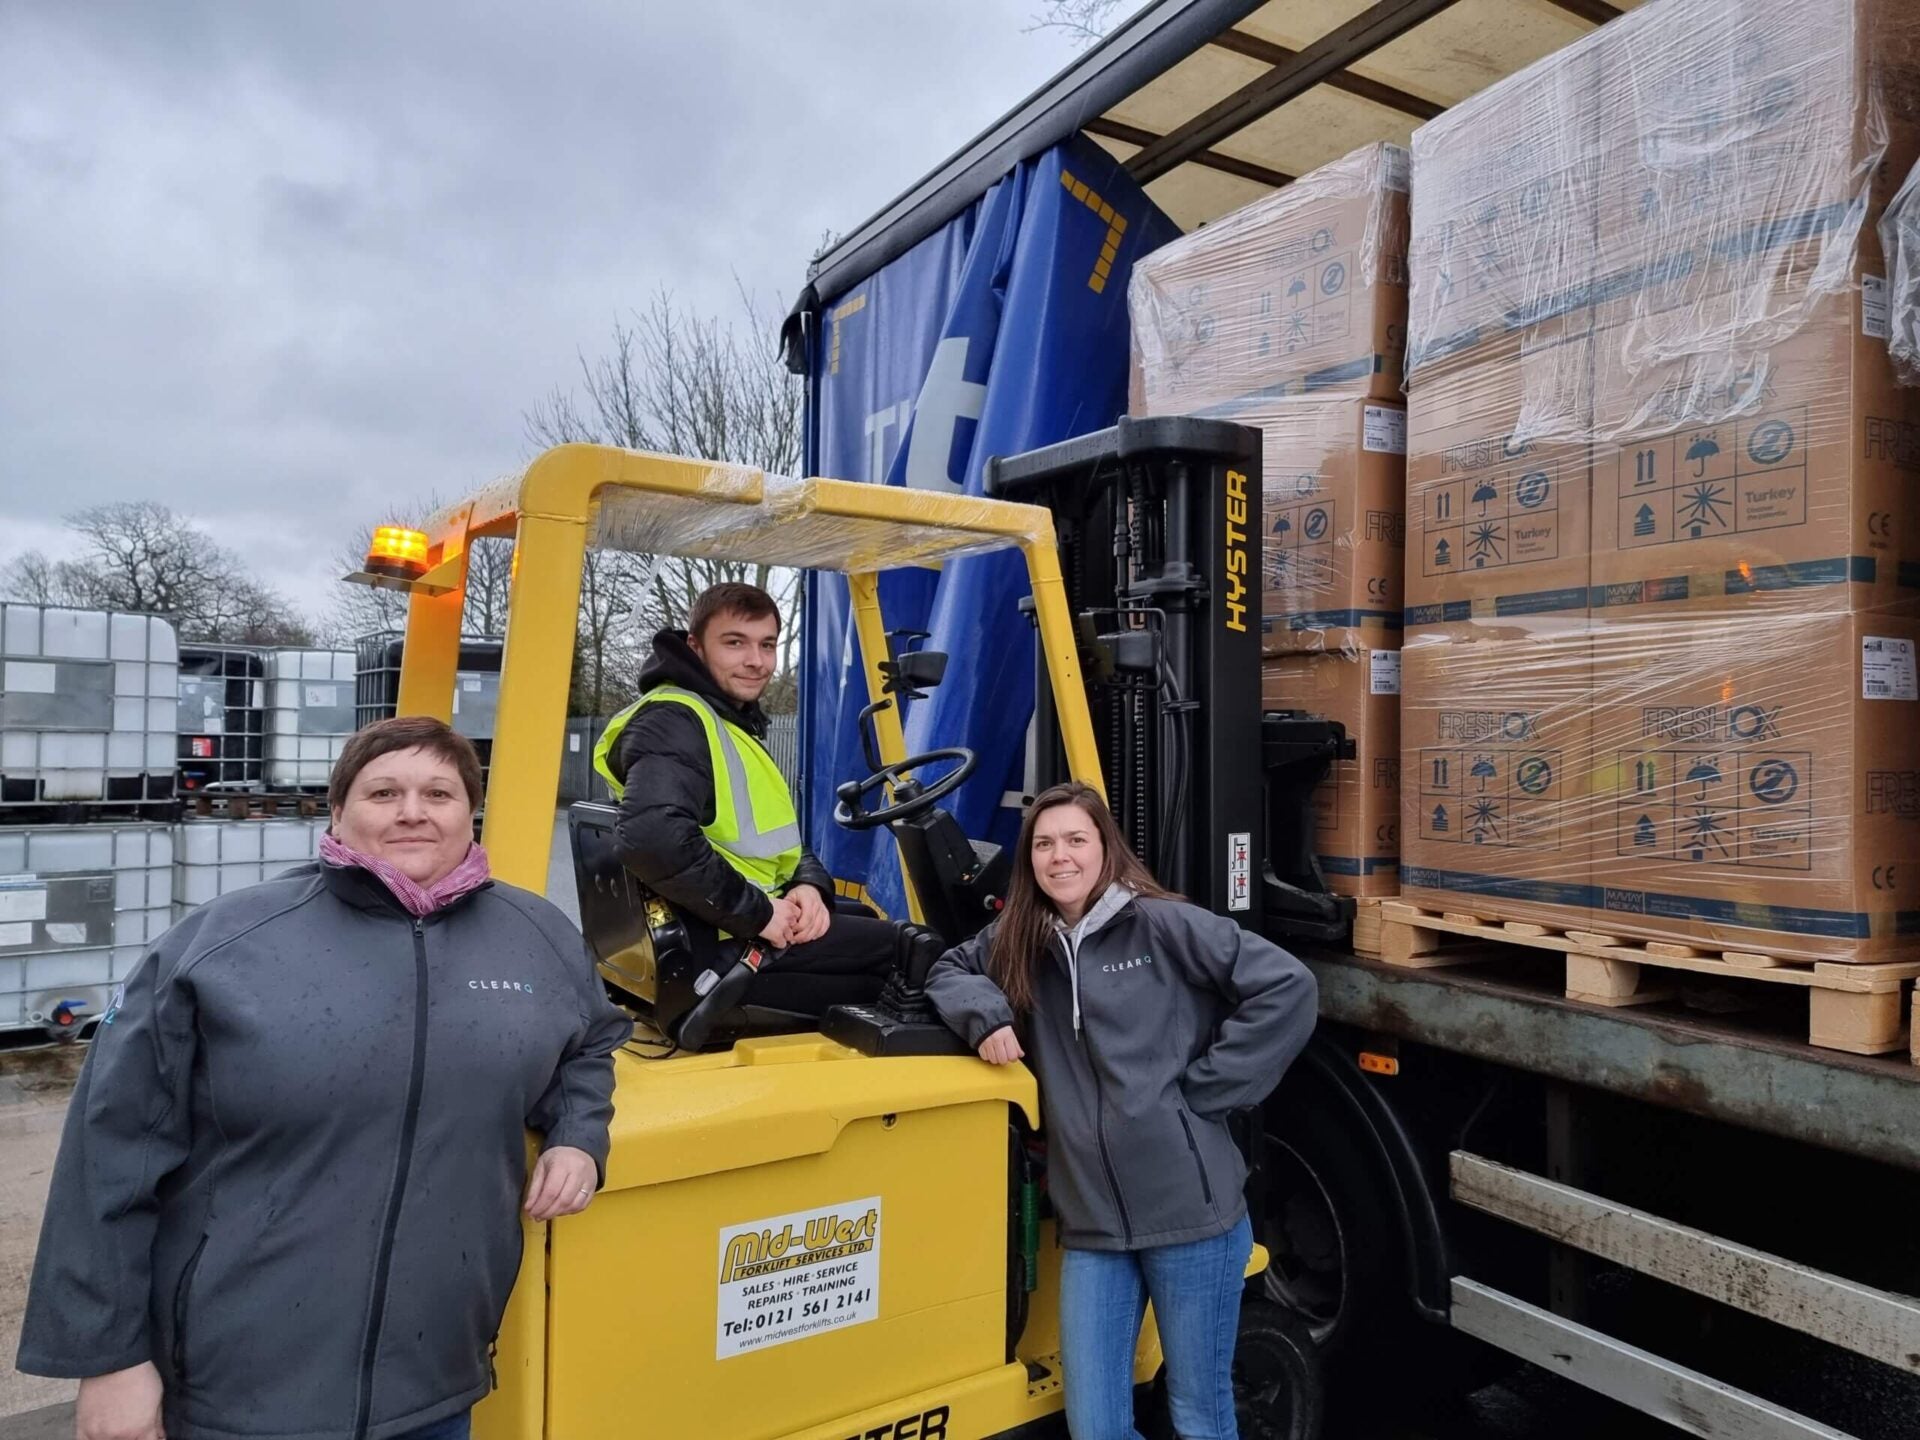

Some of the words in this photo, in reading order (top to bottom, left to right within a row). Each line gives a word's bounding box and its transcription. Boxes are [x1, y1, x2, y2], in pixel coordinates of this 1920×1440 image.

[1744, 486, 1797, 504] Turkey
[1514, 527, 1552, 540] Turkey
[1226, 470, 1247, 633] HYSTER
[1102, 955, 1152, 972] CLEARQ
[720, 1209, 878, 1284] Mid-West
[740, 1258, 790, 1278] FORKLIFT
[795, 1247, 843, 1266] SERVICES
[848, 1243, 867, 1253] LTD.
[742, 1281, 775, 1297] SALES
[783, 1273, 810, 1288] HIRE
[816, 1262, 859, 1280] SERVICE
[747, 1291, 793, 1310] REPAIRS
[802, 1276, 856, 1297] TRAINING
[802, 1298, 829, 1317] 561
[836, 1288, 871, 1309] 2141
[739, 1311, 857, 1348] www.midwestforklifts.co.uk
